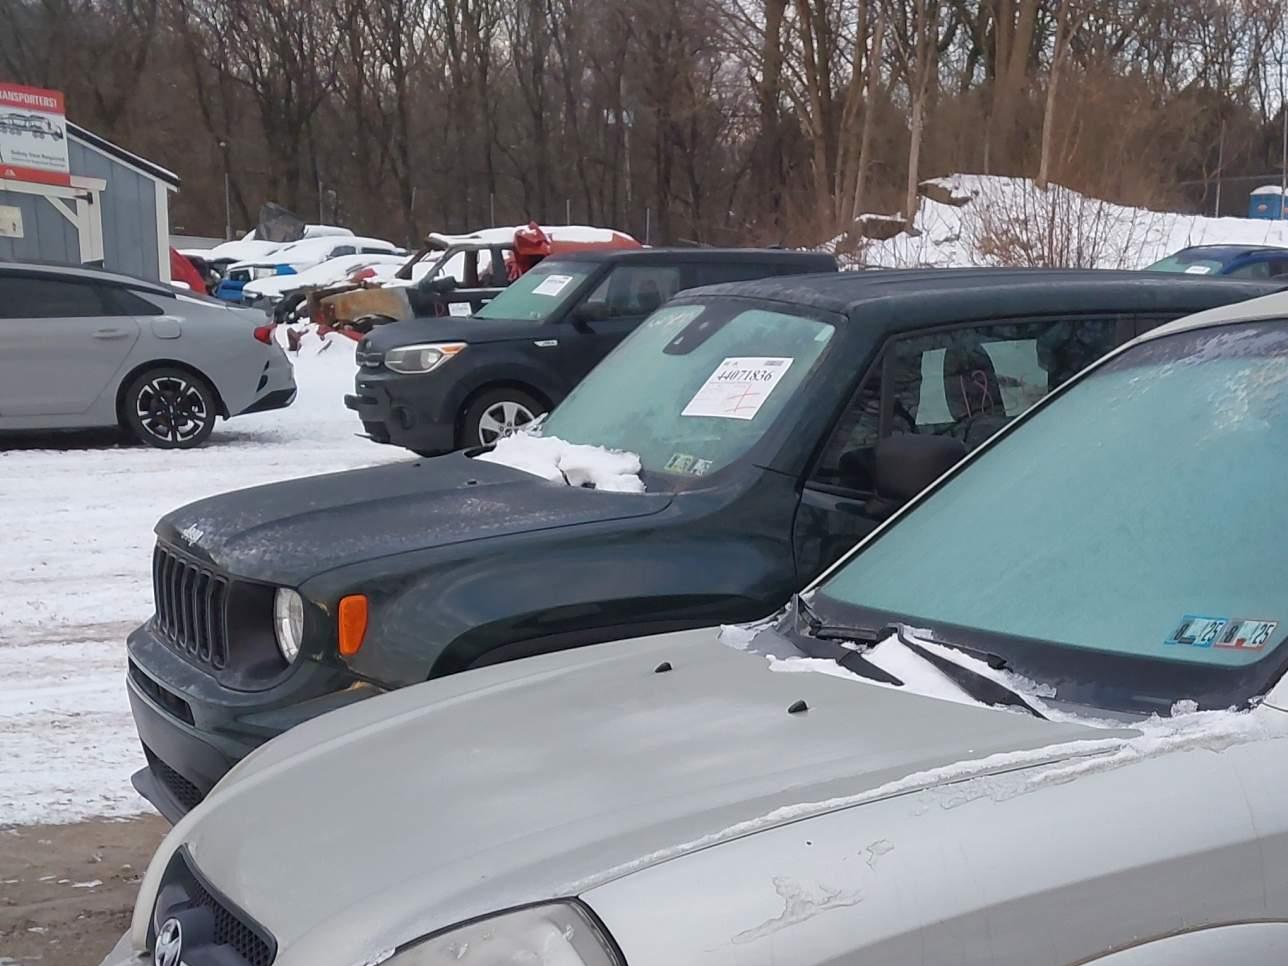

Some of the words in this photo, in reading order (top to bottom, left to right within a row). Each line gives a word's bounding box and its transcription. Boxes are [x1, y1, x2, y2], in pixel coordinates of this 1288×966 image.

[717, 369, 773, 381] 44071836
[1201, 621, 1223, 642] 25
[1253, 624, 1274, 645] 25
